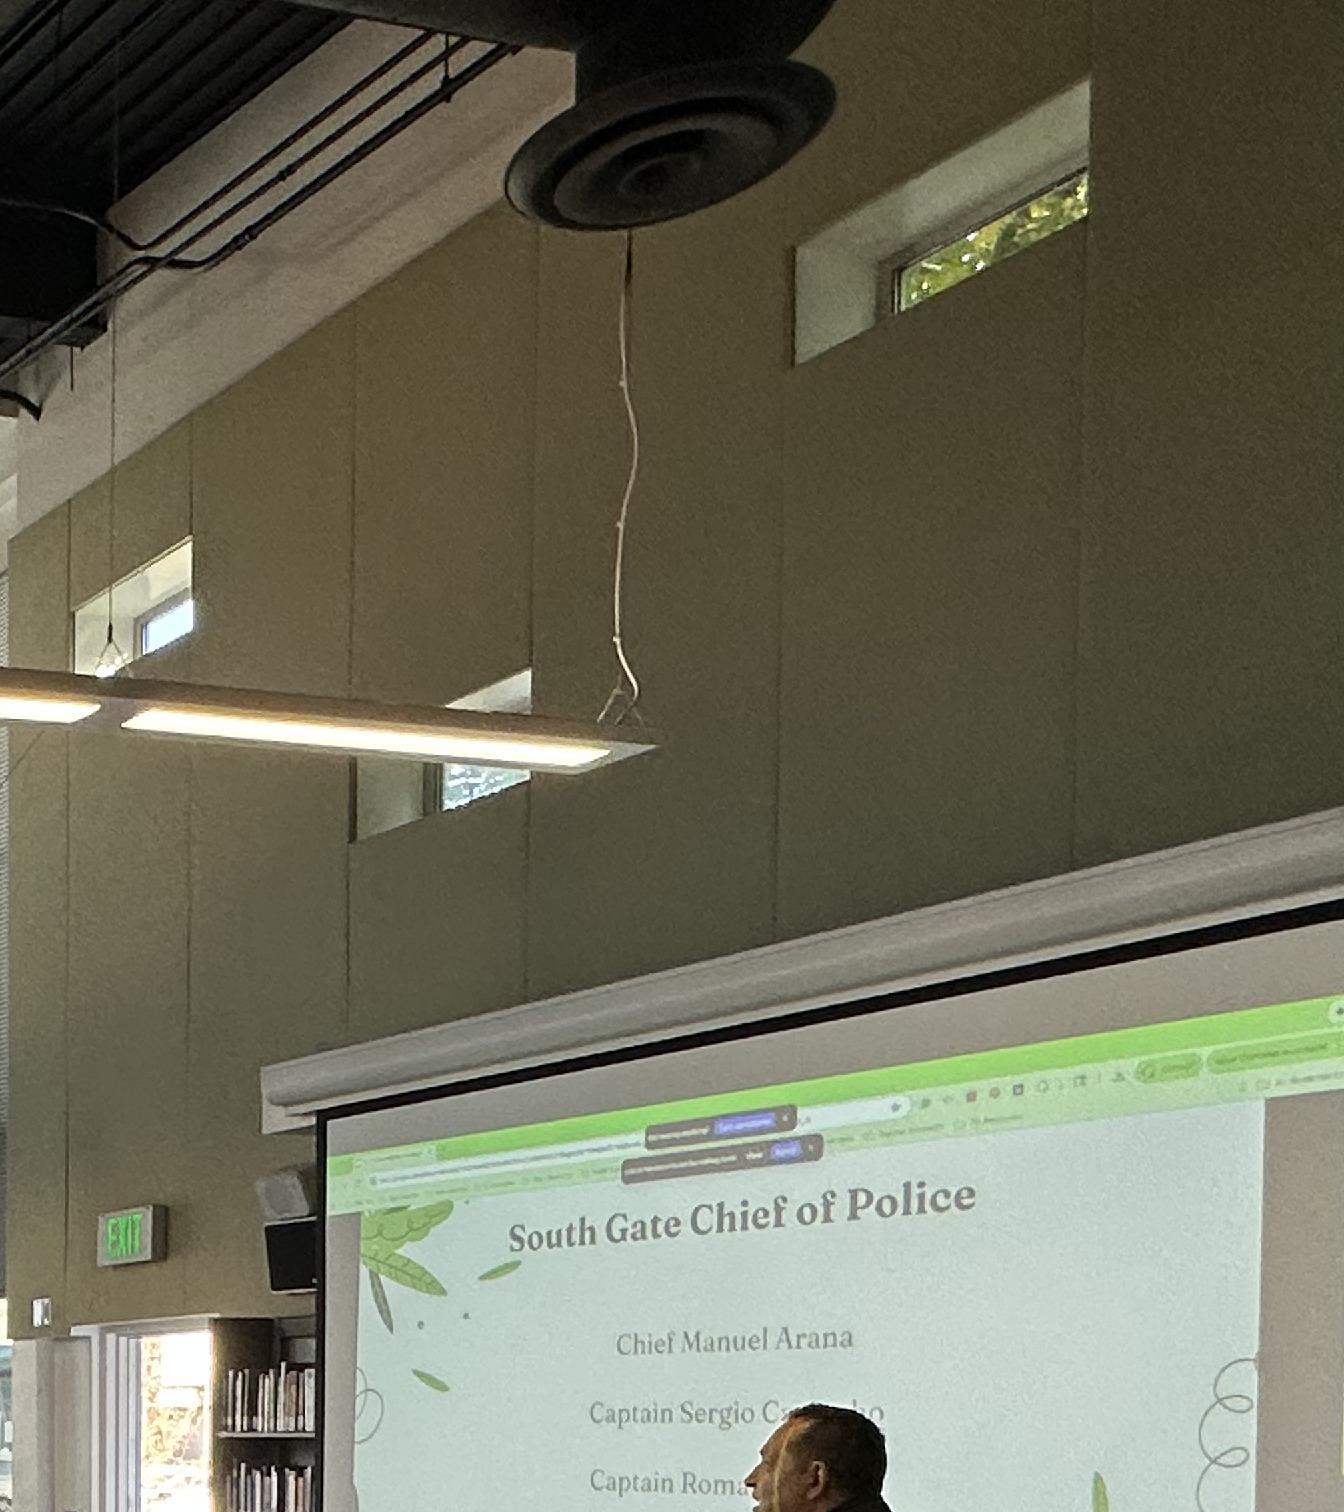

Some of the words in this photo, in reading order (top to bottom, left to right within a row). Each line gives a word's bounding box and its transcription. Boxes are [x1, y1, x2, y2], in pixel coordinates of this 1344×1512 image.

[509, 1216, 598, 1253] South
[605, 1212, 682, 1244] Gate
[690, 1194, 788, 1236] Chief
[796, 1189, 837, 1226] of
[847, 1180, 978, 1222] Police
[107, 1213, 144, 1258] EXIT
[615, 1331, 676, 1356] Chief
[680, 1326, 769, 1353] Manuel
[774, 1326, 854, 1350] Arana
[588, 1399, 674, 1430] Captain
[679, 1399, 756, 1431] Sergio
[589, 1468, 674, 1498] Captain
